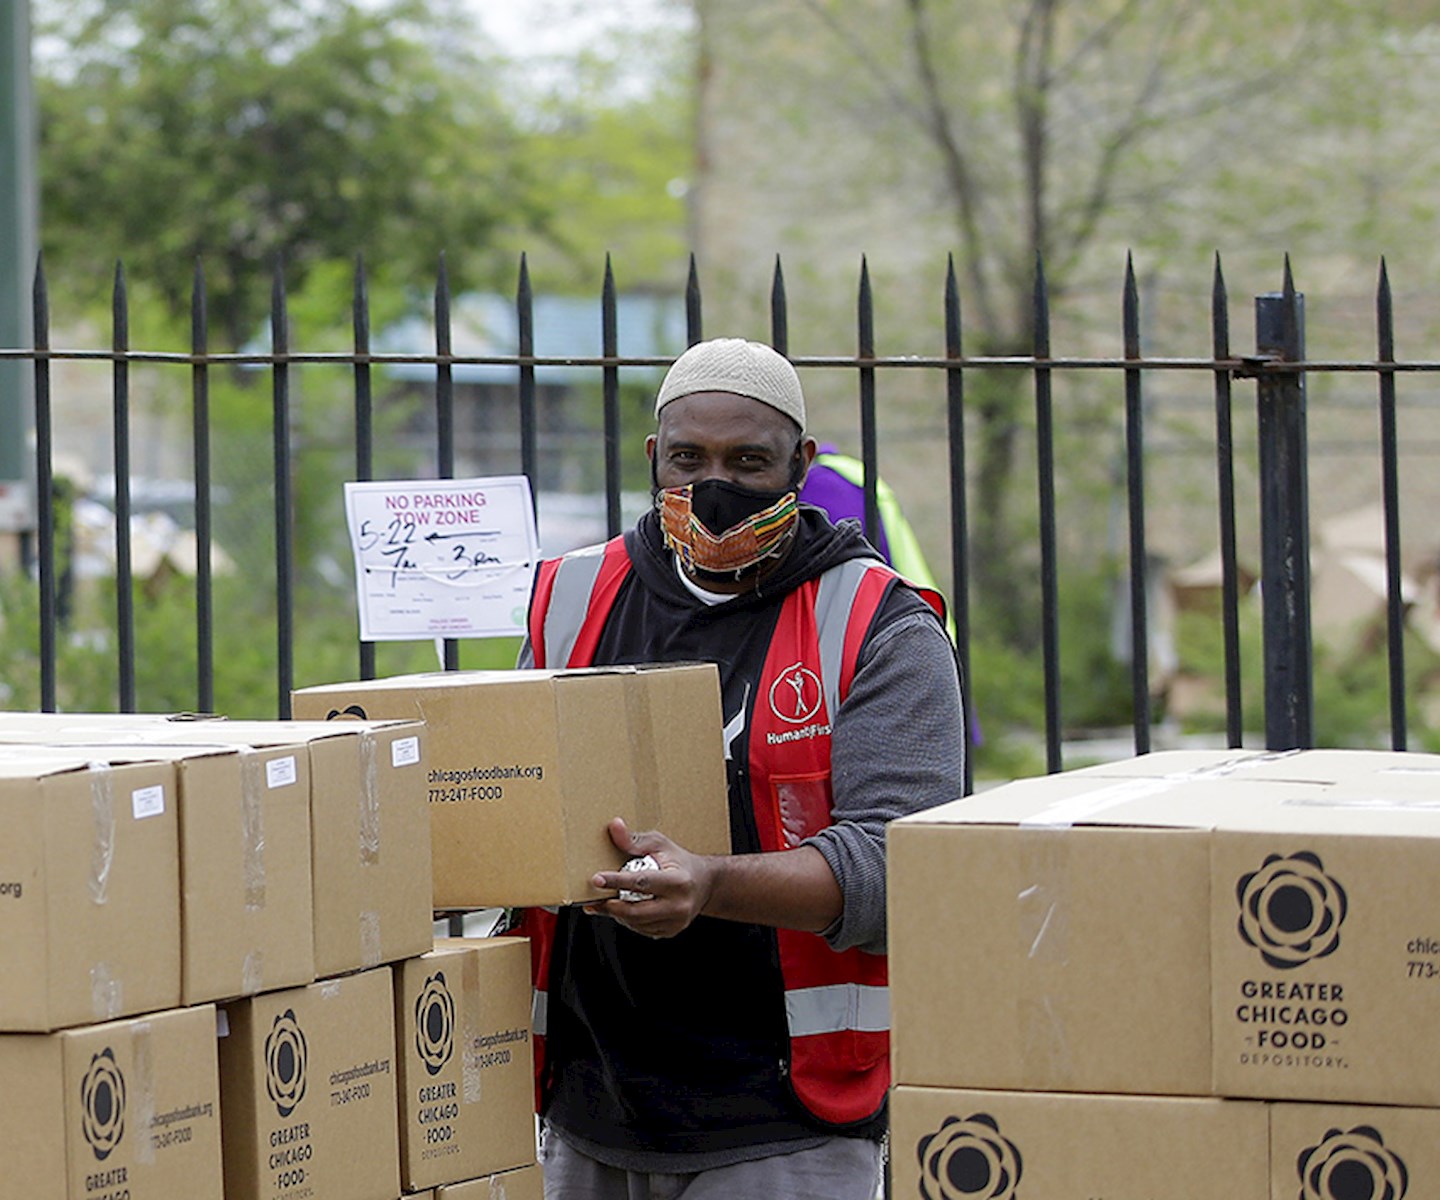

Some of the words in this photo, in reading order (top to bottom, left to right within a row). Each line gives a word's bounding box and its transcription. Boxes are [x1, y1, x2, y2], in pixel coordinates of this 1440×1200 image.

[386, 495, 409, 509] NO
[414, 492, 486, 508] PARKING
[394, 511, 430, 526] TOW
[435, 509, 480, 525] ZONE
[428, 764, 543, 784] chicagosfoodbank.org
[428, 786, 503, 802] 773-247-FOOD
[1241, 981, 1343, 1002] GREATER
[1237, 1005, 1348, 1026] CHICAGO
[270, 1123, 310, 1147] GREATER
[269, 1144, 312, 1170] CHICAGO
